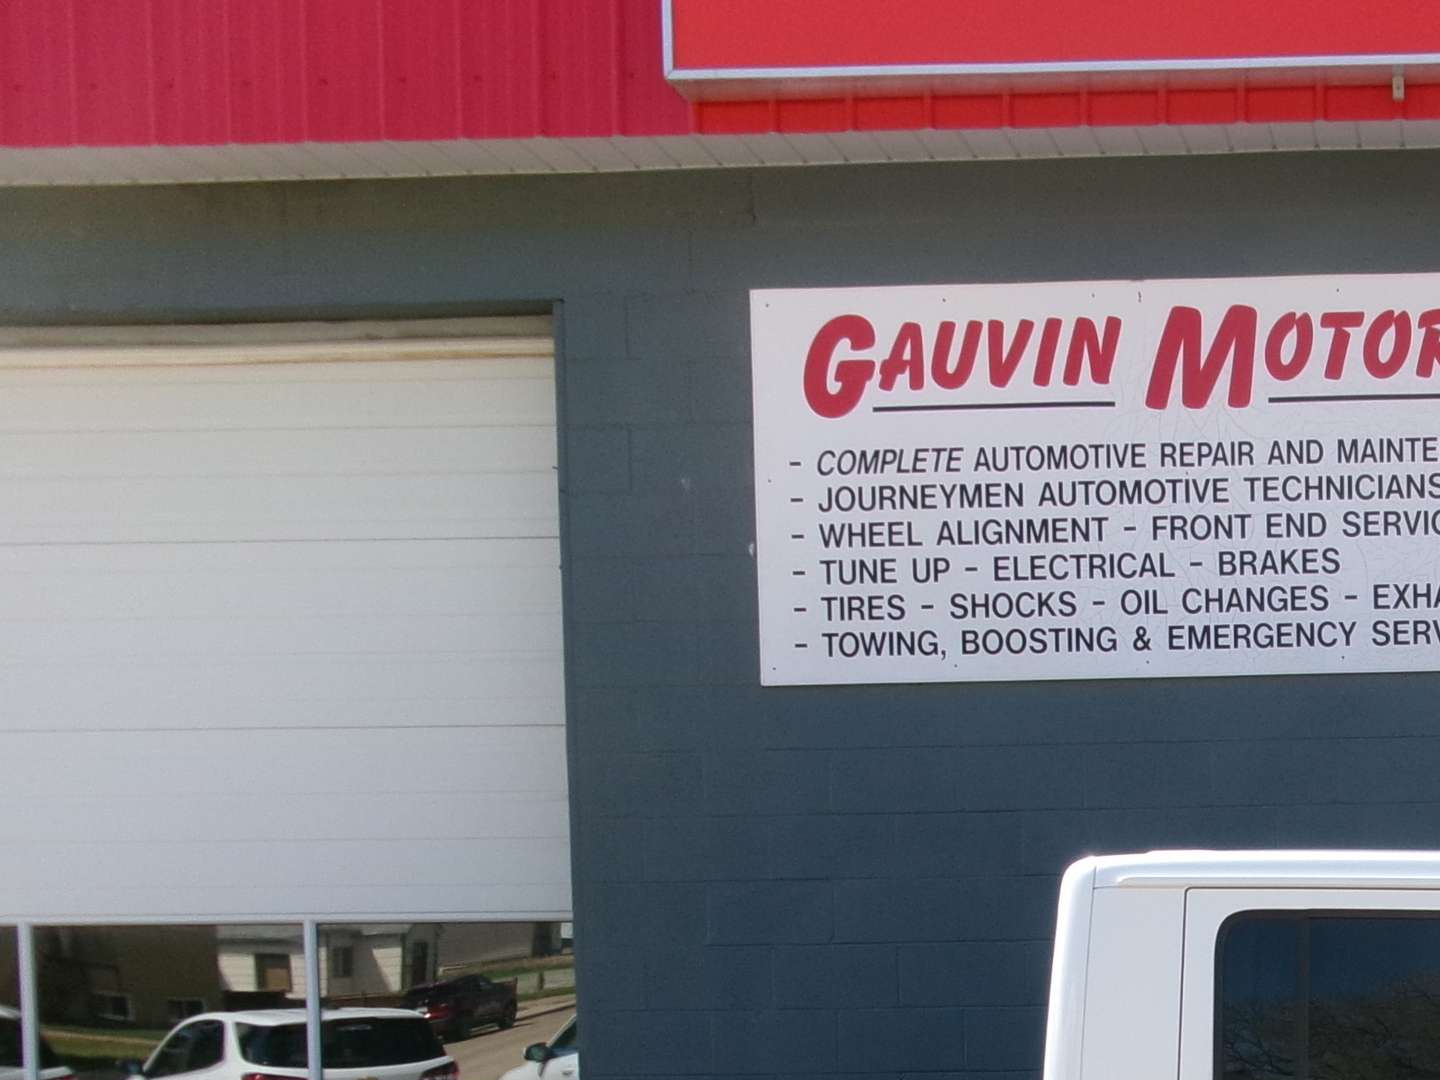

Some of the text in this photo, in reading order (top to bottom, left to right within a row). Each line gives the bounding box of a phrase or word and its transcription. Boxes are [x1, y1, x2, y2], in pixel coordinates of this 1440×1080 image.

[803, 314, 1122, 419] GAUVIN
[817, 447, 964, 477] COMPLETE
[973, 443, 1147, 473] AUTOMOTIVE
[1160, 440, 1254, 468] REPAIR
[1267, 439, 1324, 466] AND
[818, 482, 1024, 513] JOURNEYMEN
[1038, 477, 1230, 507] AUTOMOTIVE
[818, 521, 924, 549] WHEEL
[936, 516, 1109, 546] ALIGNMENT
[1152, 513, 1252, 541] FRONT
[1266, 512, 1327, 539] END
[819, 558, 898, 586] TUNE
[911, 557, 951, 584] UP
[993, 552, 1176, 582] ELECTRICAL
[1218, 547, 1341, 577] BRAKES
[820, 594, 906, 622] TIRES
[949, 590, 1077, 620] SHOCKS
[1120, 589, 1169, 616] OIL
[1181, 584, 1329, 615] CHANGES
[821, 629, 947, 661] TOWING,
[961, 625, 1118, 656] BOOSTING
[1132, 625, 1153, 652] &
[1167, 620, 1357, 651] EMERGENCY
